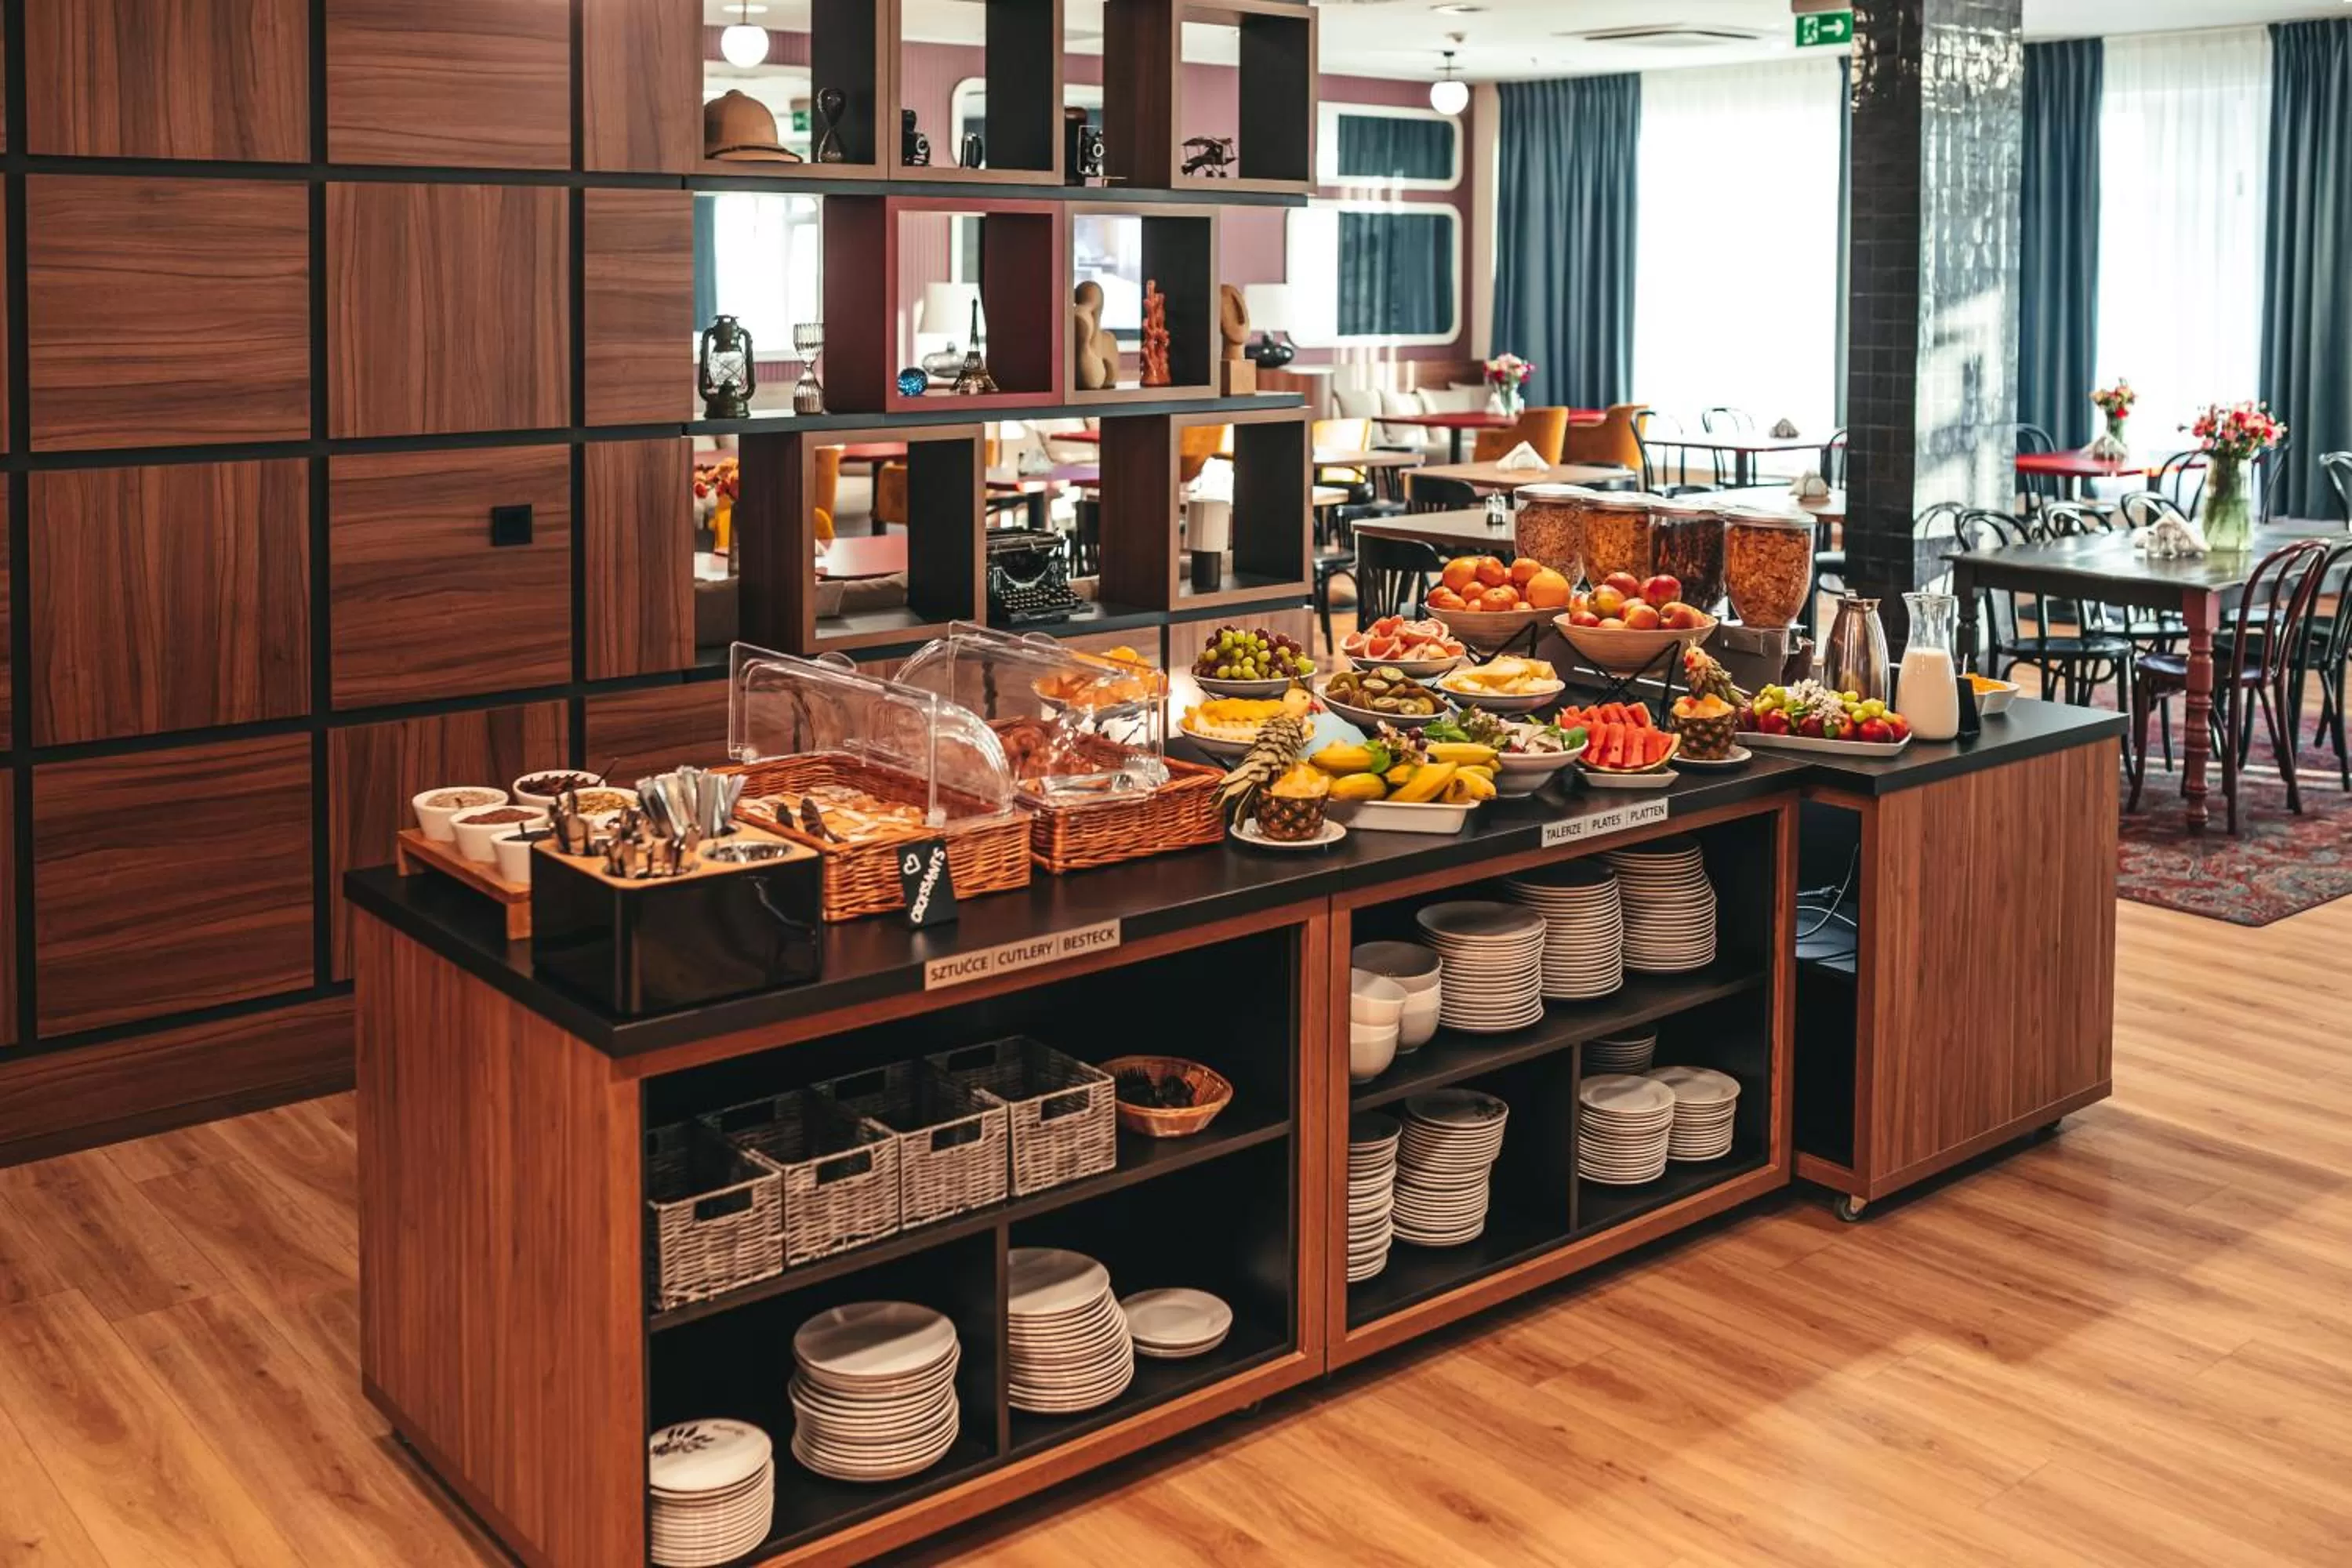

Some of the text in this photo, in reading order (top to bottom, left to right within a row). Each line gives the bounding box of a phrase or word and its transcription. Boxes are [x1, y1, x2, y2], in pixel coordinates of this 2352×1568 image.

[1546, 804, 1665, 840] TALERZE PLATES PLATTEN
[931, 927, 1116, 982] SZTUĆCE CUTLERY BESTECK
